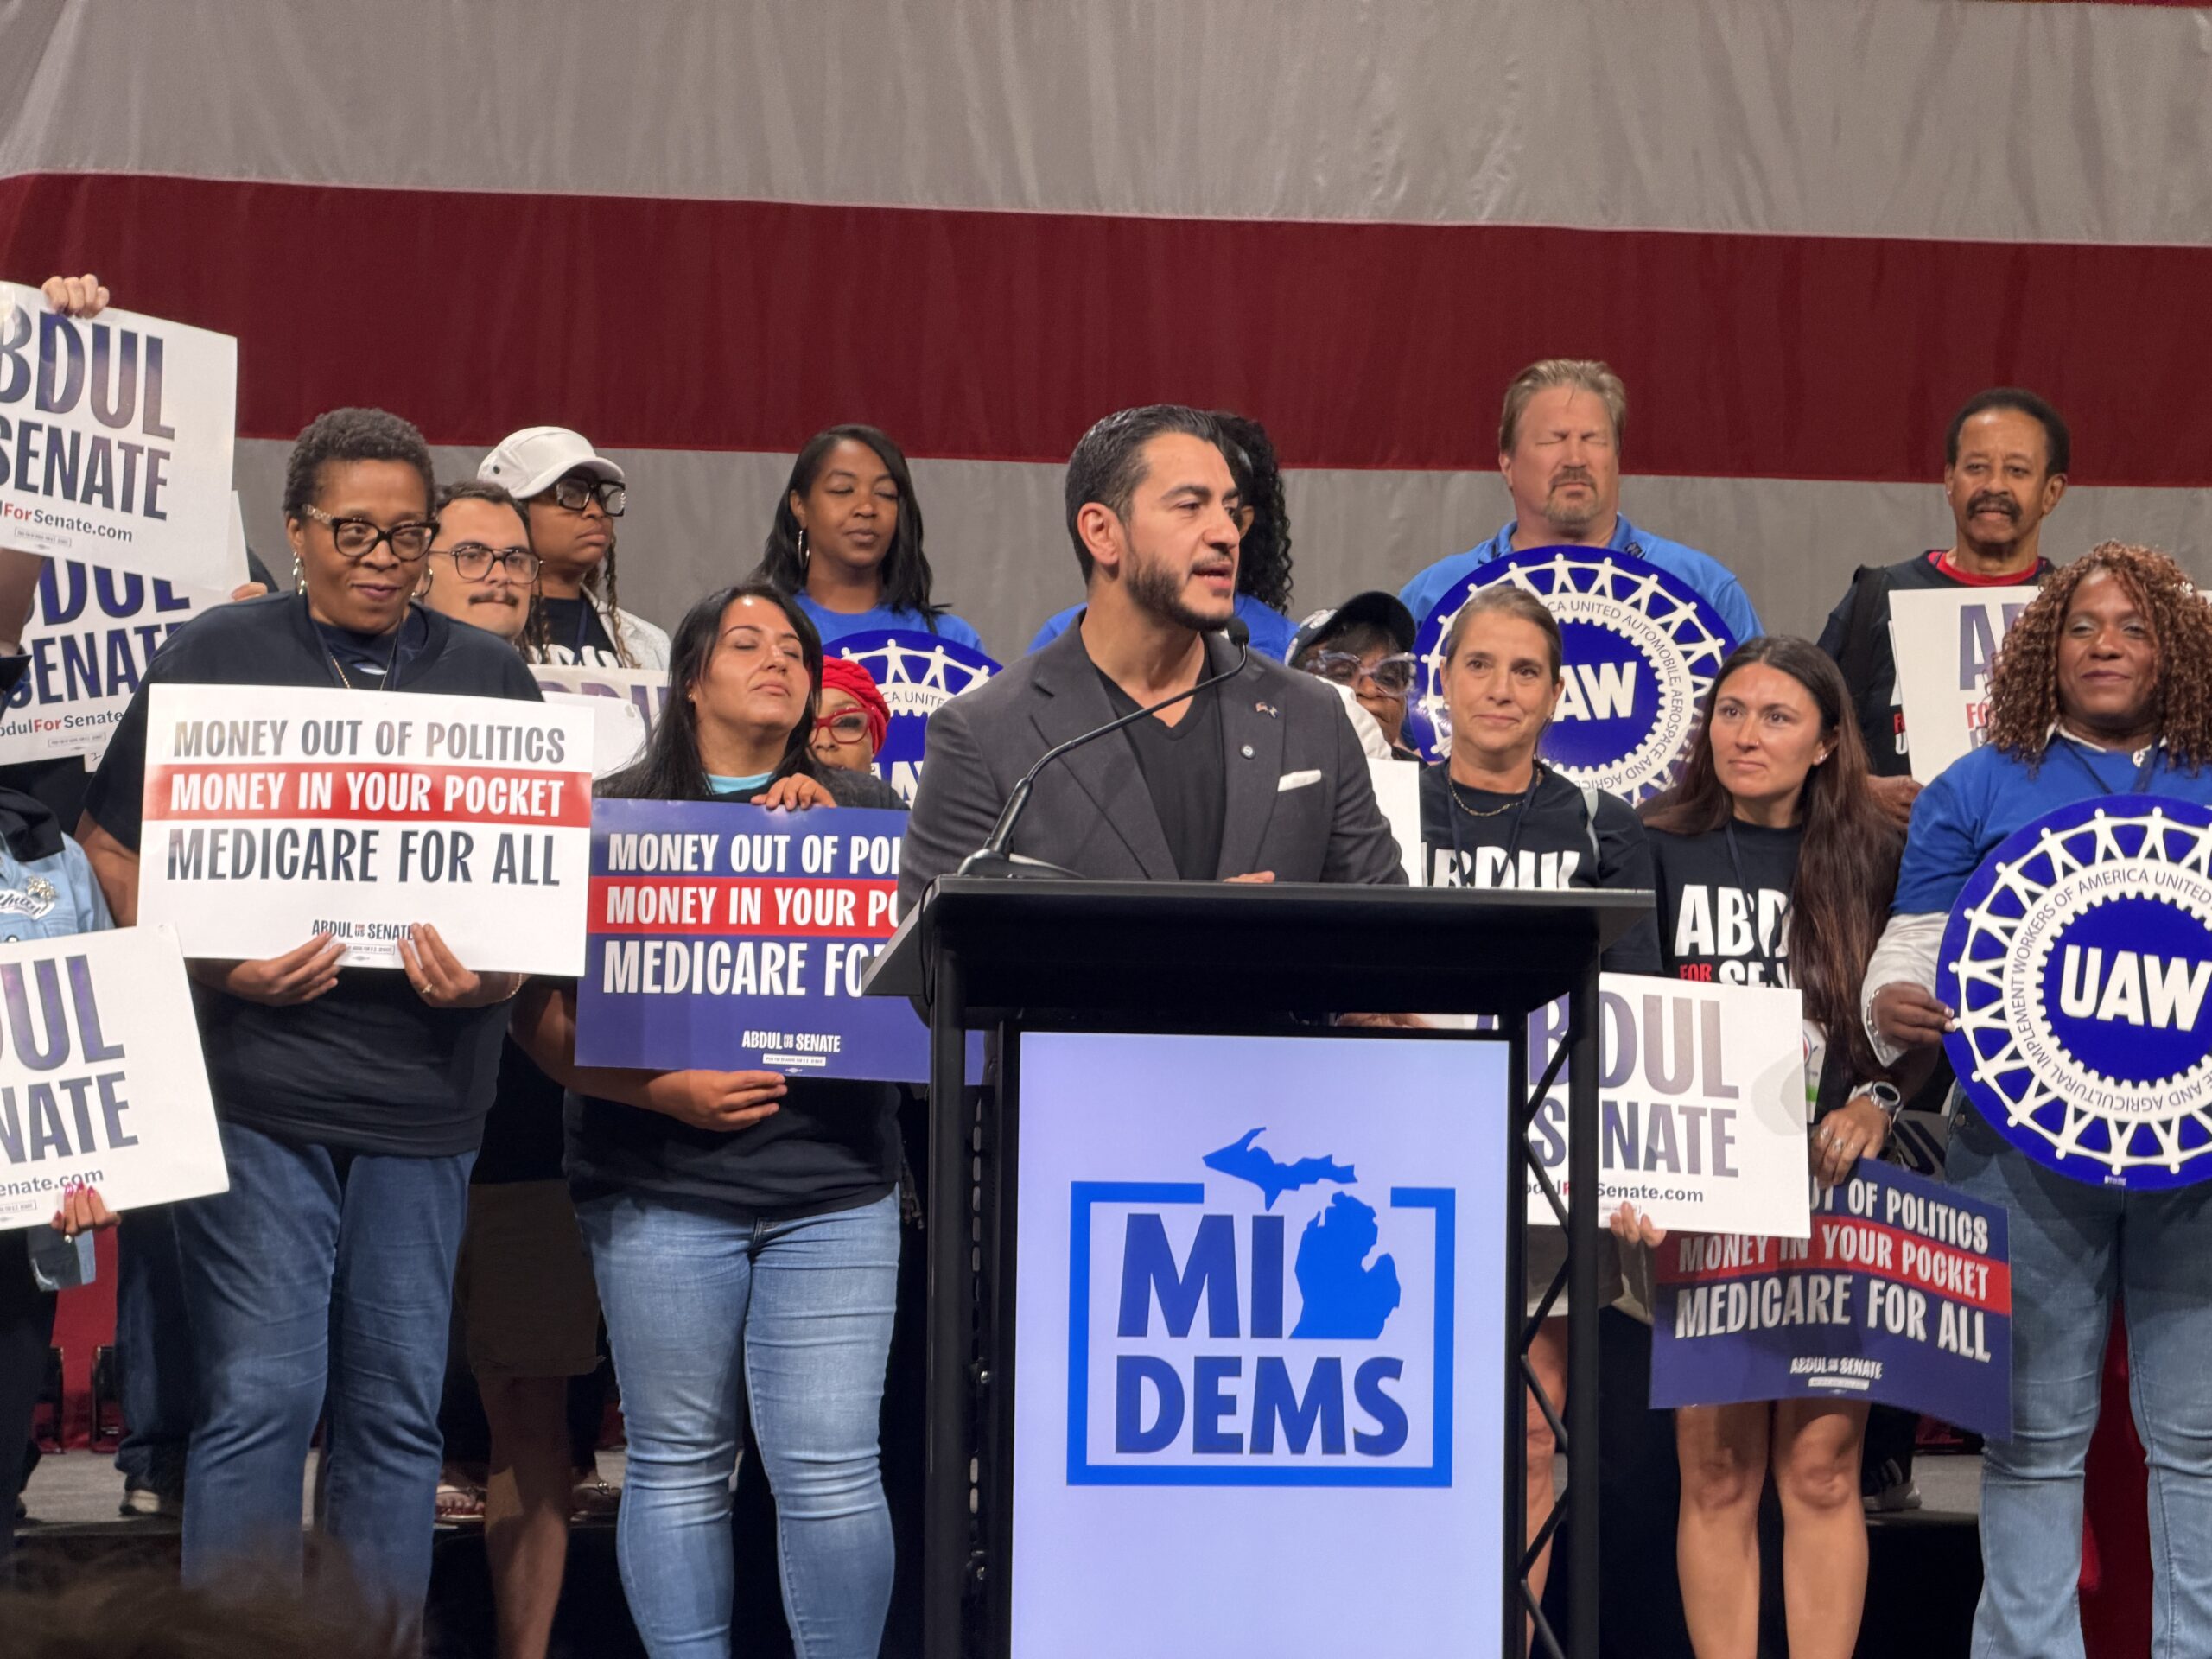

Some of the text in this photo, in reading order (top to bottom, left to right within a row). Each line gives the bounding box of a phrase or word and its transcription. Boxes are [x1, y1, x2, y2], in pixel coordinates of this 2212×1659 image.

[0, 304, 175, 440] BDUL
[28, 557, 191, 626] DUL
[1571, 601, 1621, 619] UNITED
[8, 620, 189, 709] ENAT
[1552, 661, 1637, 722] AW
[174, 720, 566, 763] MONEY OUT OF POLITICS
[1649, 689, 1684, 760] AEROSPACE
[171, 772, 565, 817] MONEY IN YOUR POCKET
[1625, 754, 1652, 779] AND
[167, 827, 560, 887] MEDICARE FOR ALL
[608, 834, 719, 873] MONEY
[730, 834, 790, 874] OUT
[801, 835, 838, 874] OF
[312, 919, 353, 938] ABDUL
[606, 887, 717, 925] MONEY
[728, 887, 761, 925] IN
[774, 887, 855, 927] YOUR
[1675, 884, 1794, 958] ABD
[603, 940, 886, 997] MEDICARE FO
[2011, 868, 2212, 1113] AND AGRICULTURAL IMPLEMENT WORKERS OF AMERICA UNITED
[2060, 944, 2212, 1032] UAW
[0, 954, 125, 1071] UL
[742, 1030, 783, 1050] ABDUL
[796, 1033, 841, 1052] SENATE
[1529, 991, 1739, 1100] BDUL
[1530, 1096, 1739, 1179] SNATE
[1847, 1178, 1878, 1215] OF
[1886, 1192, 1988, 1254] POLITICS
[1117, 1213, 1284, 1339] MI
[1679, 1224, 1989, 1301] MONEY IN YOUR POCKET
[1675, 1274, 1992, 1363] MEDICARE FOR ALL
[1116, 1354, 1409, 1457] DEMS
